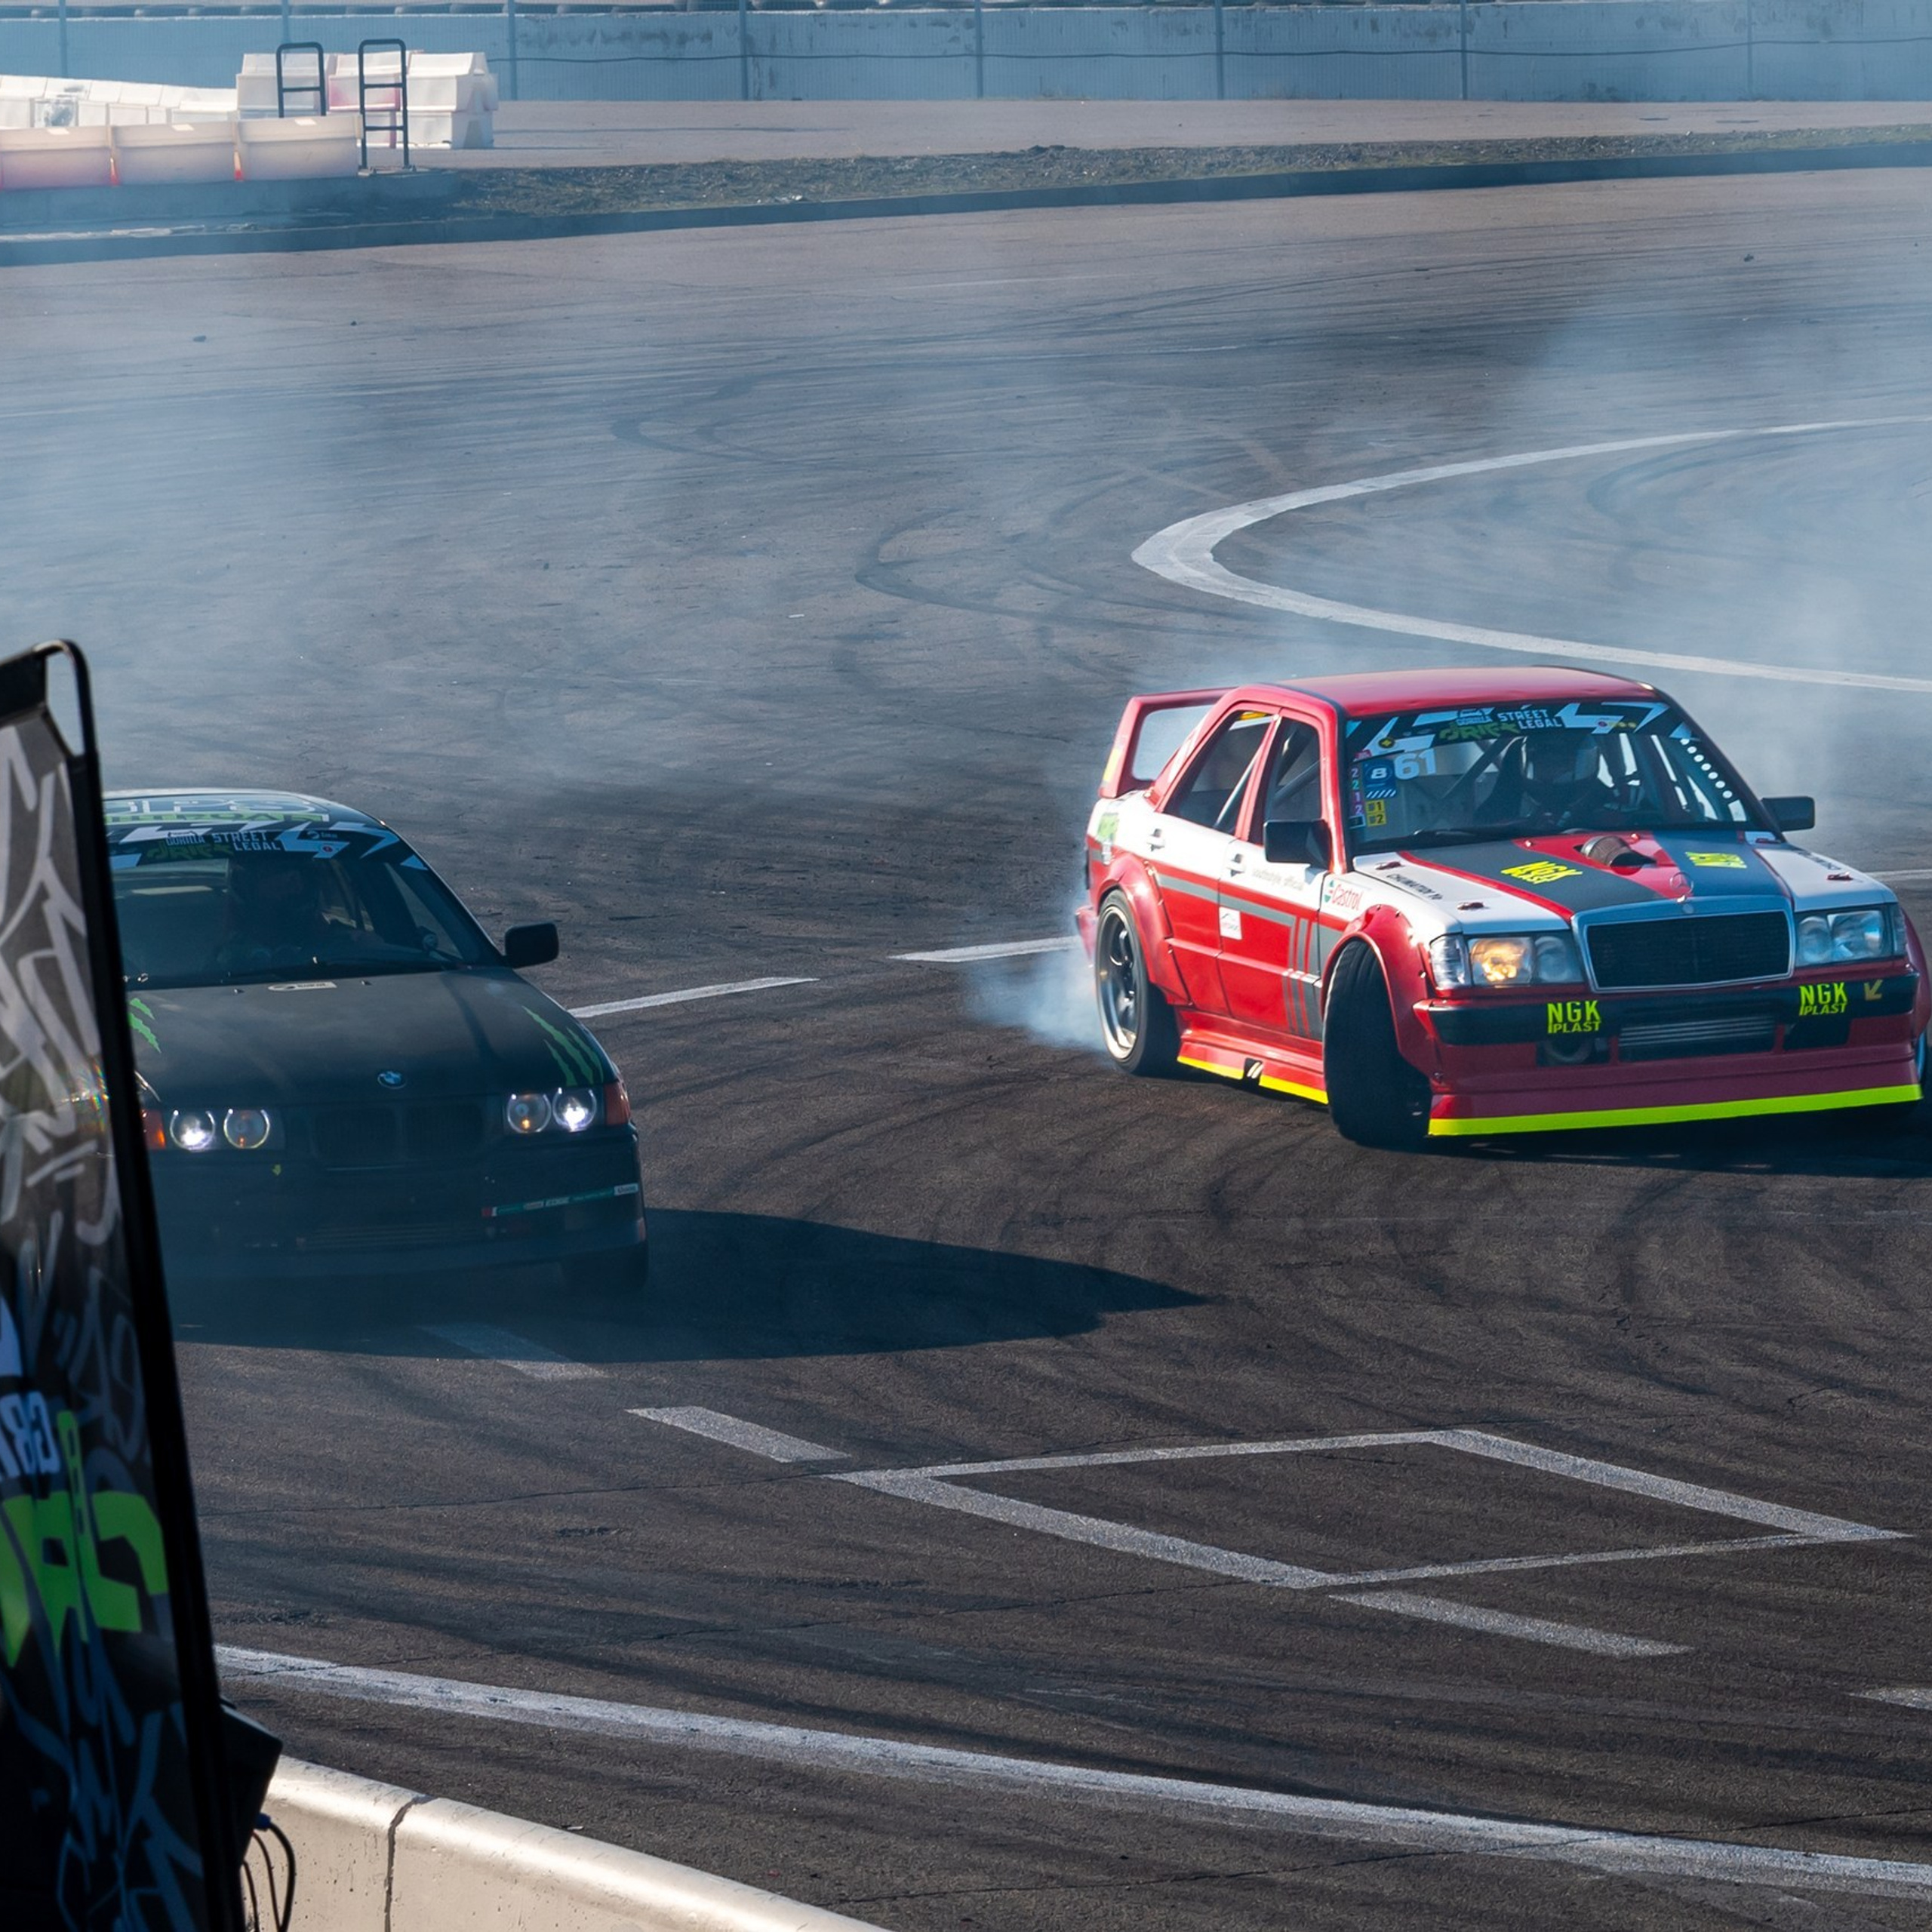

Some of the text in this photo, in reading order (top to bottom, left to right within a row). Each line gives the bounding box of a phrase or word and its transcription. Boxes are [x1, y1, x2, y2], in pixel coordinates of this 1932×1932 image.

[1497, 708, 1549, 722] STREET
[1518, 718, 1563, 730] LEGAL
[1394, 747, 1436, 780] 61
[1371, 768, 1387, 780] 8
[211, 830, 267, 843] STREET
[233, 841, 281, 851] LEGAL
[1331, 884, 1364, 911] Castrol
[1798, 982, 1848, 1005] NGK
[1547, 1000, 1601, 1023] NGK
[1799, 1003, 1847, 1016] PLAST
[1549, 1021, 1601, 1034] PLAST
